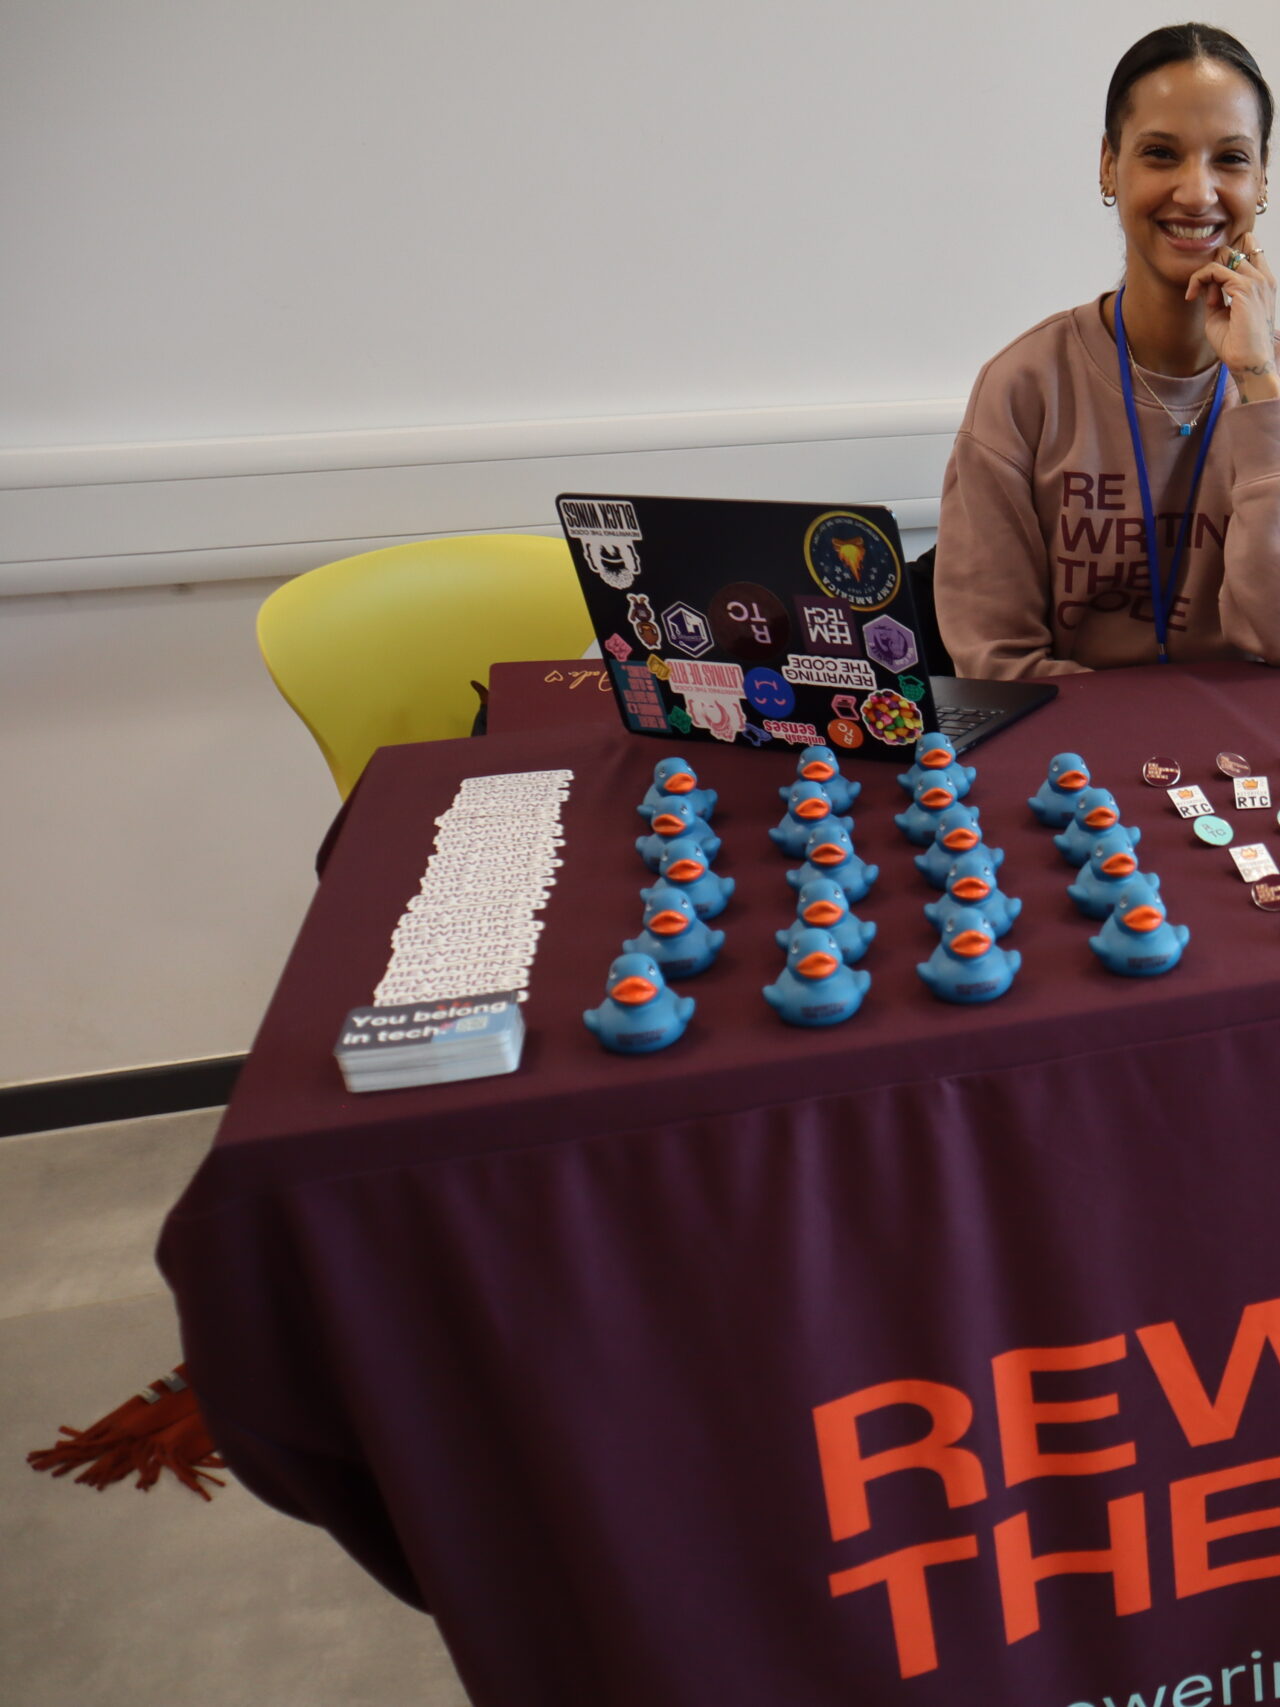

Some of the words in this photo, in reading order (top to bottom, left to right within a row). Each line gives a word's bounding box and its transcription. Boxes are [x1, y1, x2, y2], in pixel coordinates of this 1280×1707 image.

[1063, 471, 1126, 510] RE
[562, 502, 600, 529] WINGS
[598, 503, 637, 530] BLACK
[1057, 557, 1153, 594] THE
[822, 575, 874, 606] AMERICA
[876, 573, 897, 602] CAMP
[726, 601, 768, 622] TC
[803, 606, 848, 626] TECH
[754, 624, 772, 643] R
[686, 663, 704, 686] DE
[791, 657, 842, 672] CODE
[845, 662, 872, 674] THE
[702, 664, 742, 689] LATINAS
[785, 666, 874, 687] REWRITING
[763, 720, 816, 737] senses
[784, 734, 825, 746] unleash
[1180, 803, 1212, 818] RTC
[1238, 796, 1269, 807] RTC
[352, 1015, 408, 1028] You
[413, 1001, 509, 1022] belong
[343, 1032, 371, 1045] in
